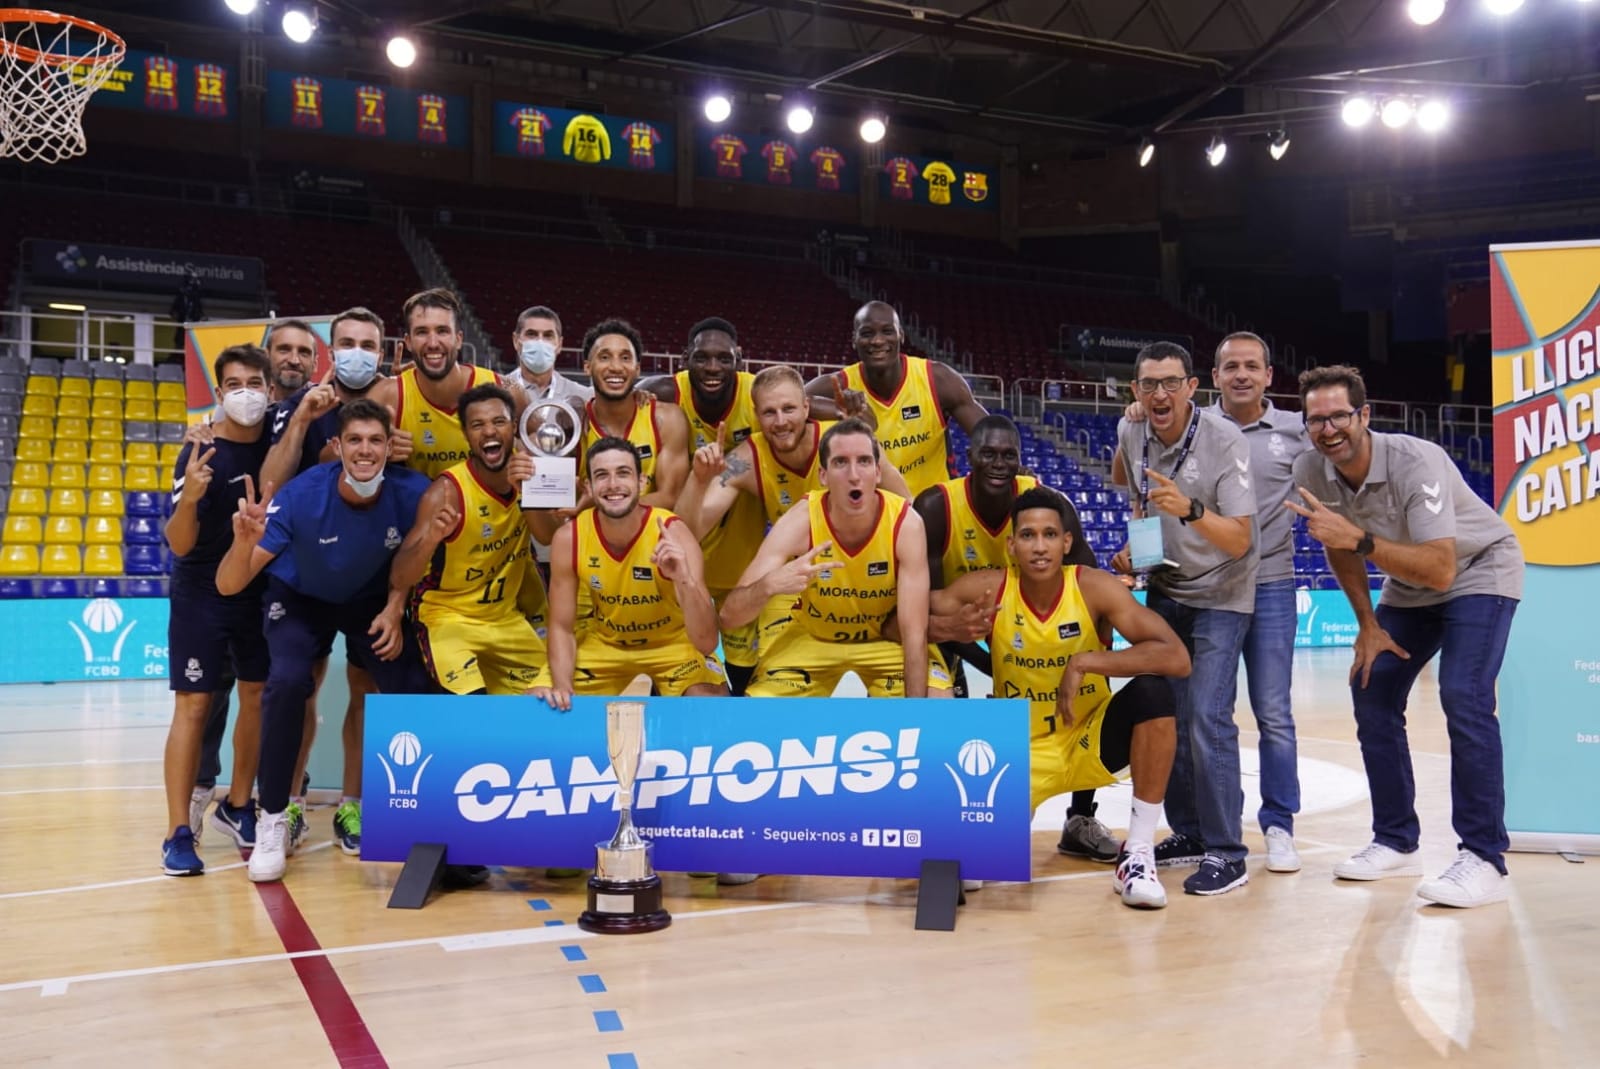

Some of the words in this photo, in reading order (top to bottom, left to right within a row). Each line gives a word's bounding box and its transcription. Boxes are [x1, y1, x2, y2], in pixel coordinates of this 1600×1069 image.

[197, 77, 222, 96] 12
[296, 91, 317, 109] 11
[363, 99, 377, 116] 7
[425, 108, 439, 123] 4
[521, 120, 541, 137] 21
[578, 128, 597, 143] 16
[632, 135, 652, 150] 14
[724, 145, 735, 160] 7
[897, 168, 907, 182] 2
[931, 173, 948, 187] 28
[1512, 325, 1600, 403] LLIG
[477, 577, 506, 605] 11
[606, 616, 671, 633] Andorra
[144, 662, 164, 675] de
[453, 728, 920, 822] CAMPIONS!
[390, 799, 417, 809] FCBQ
[961, 812, 994, 823] FCBQ
[763, 827, 846, 843] Segueix-nos
[850, 832, 858, 842] a
